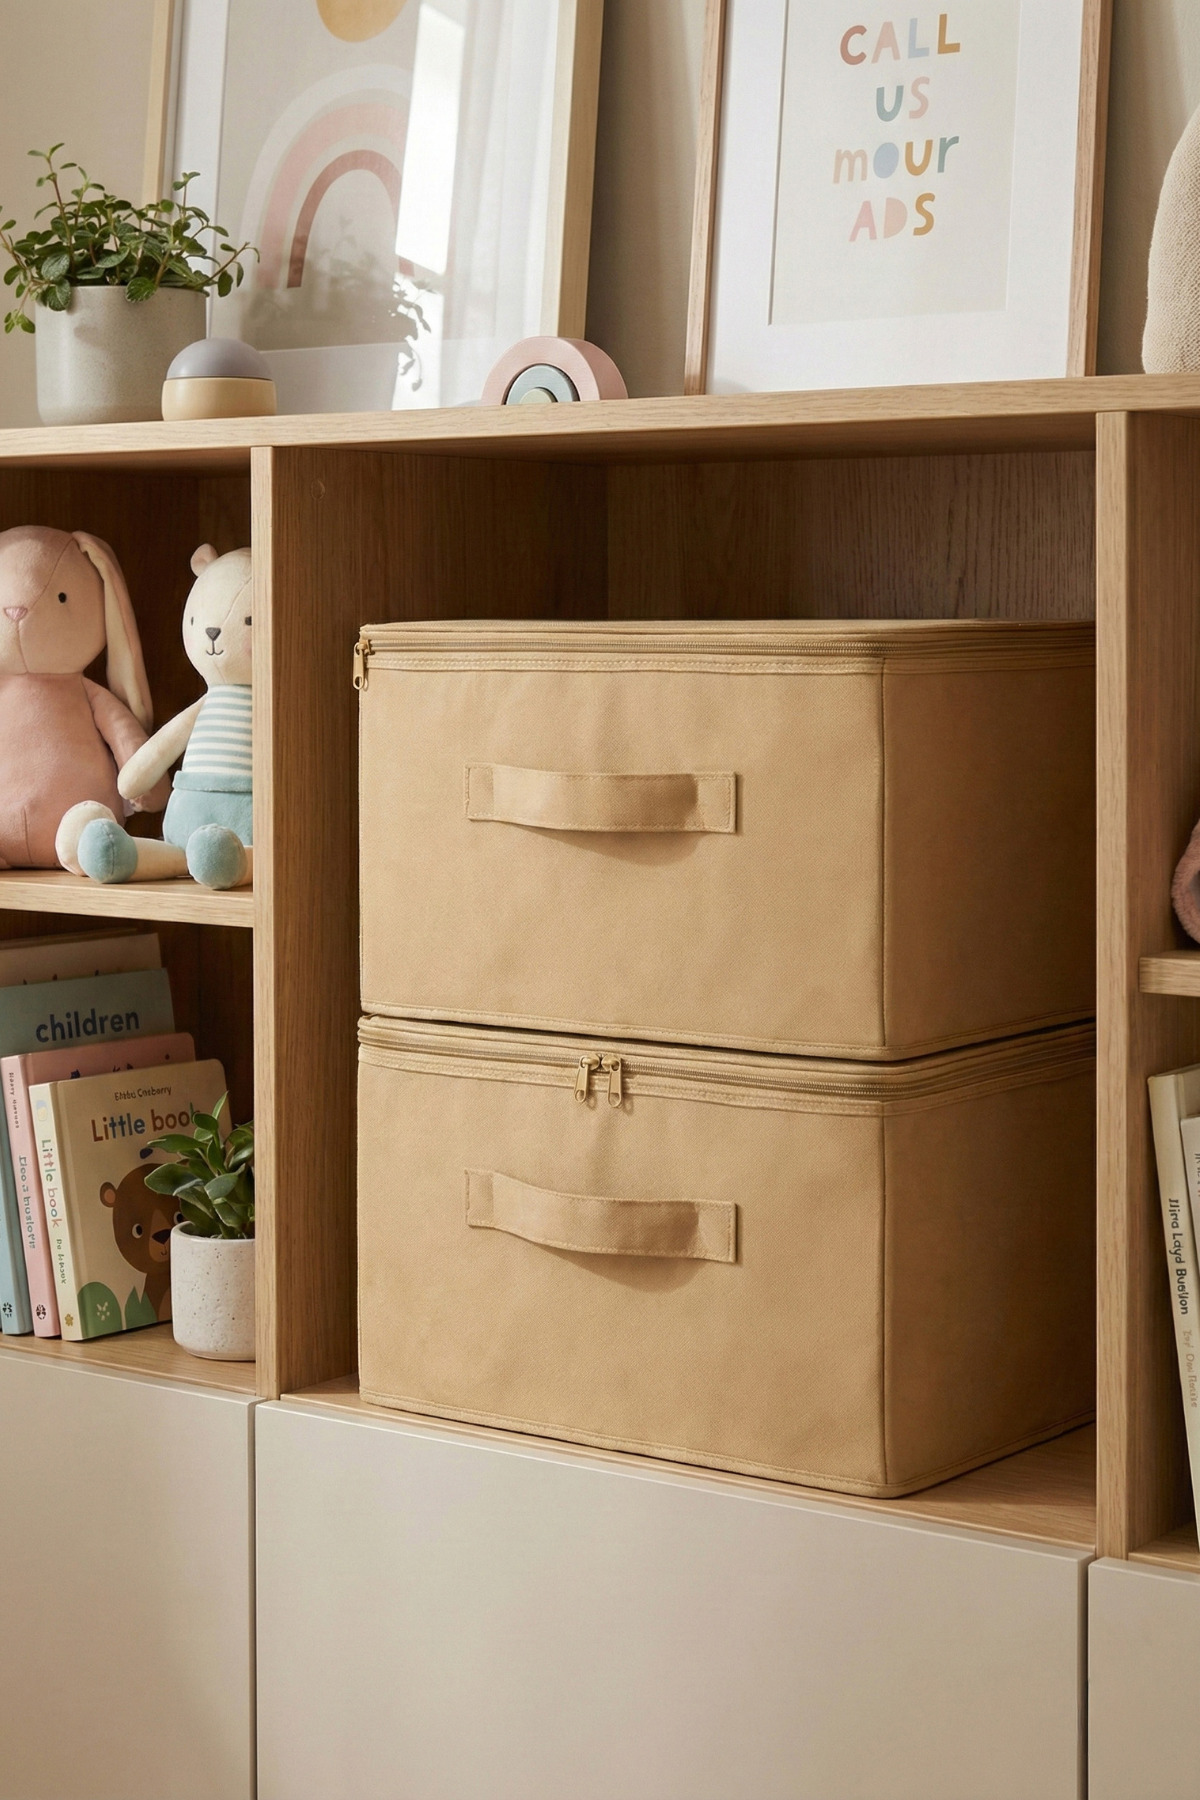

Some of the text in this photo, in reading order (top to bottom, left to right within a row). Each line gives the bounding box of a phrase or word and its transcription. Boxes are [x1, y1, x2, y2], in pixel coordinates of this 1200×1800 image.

[840, 13, 960, 66] CALL
[875, 76, 931, 122] US
[848, 192, 936, 242] ADS
[35, 1008, 140, 1043] children
[91, 1108, 200, 1142] Little boo
[41, 1139, 57, 1182] Little
[47, 1187, 63, 1229] book
